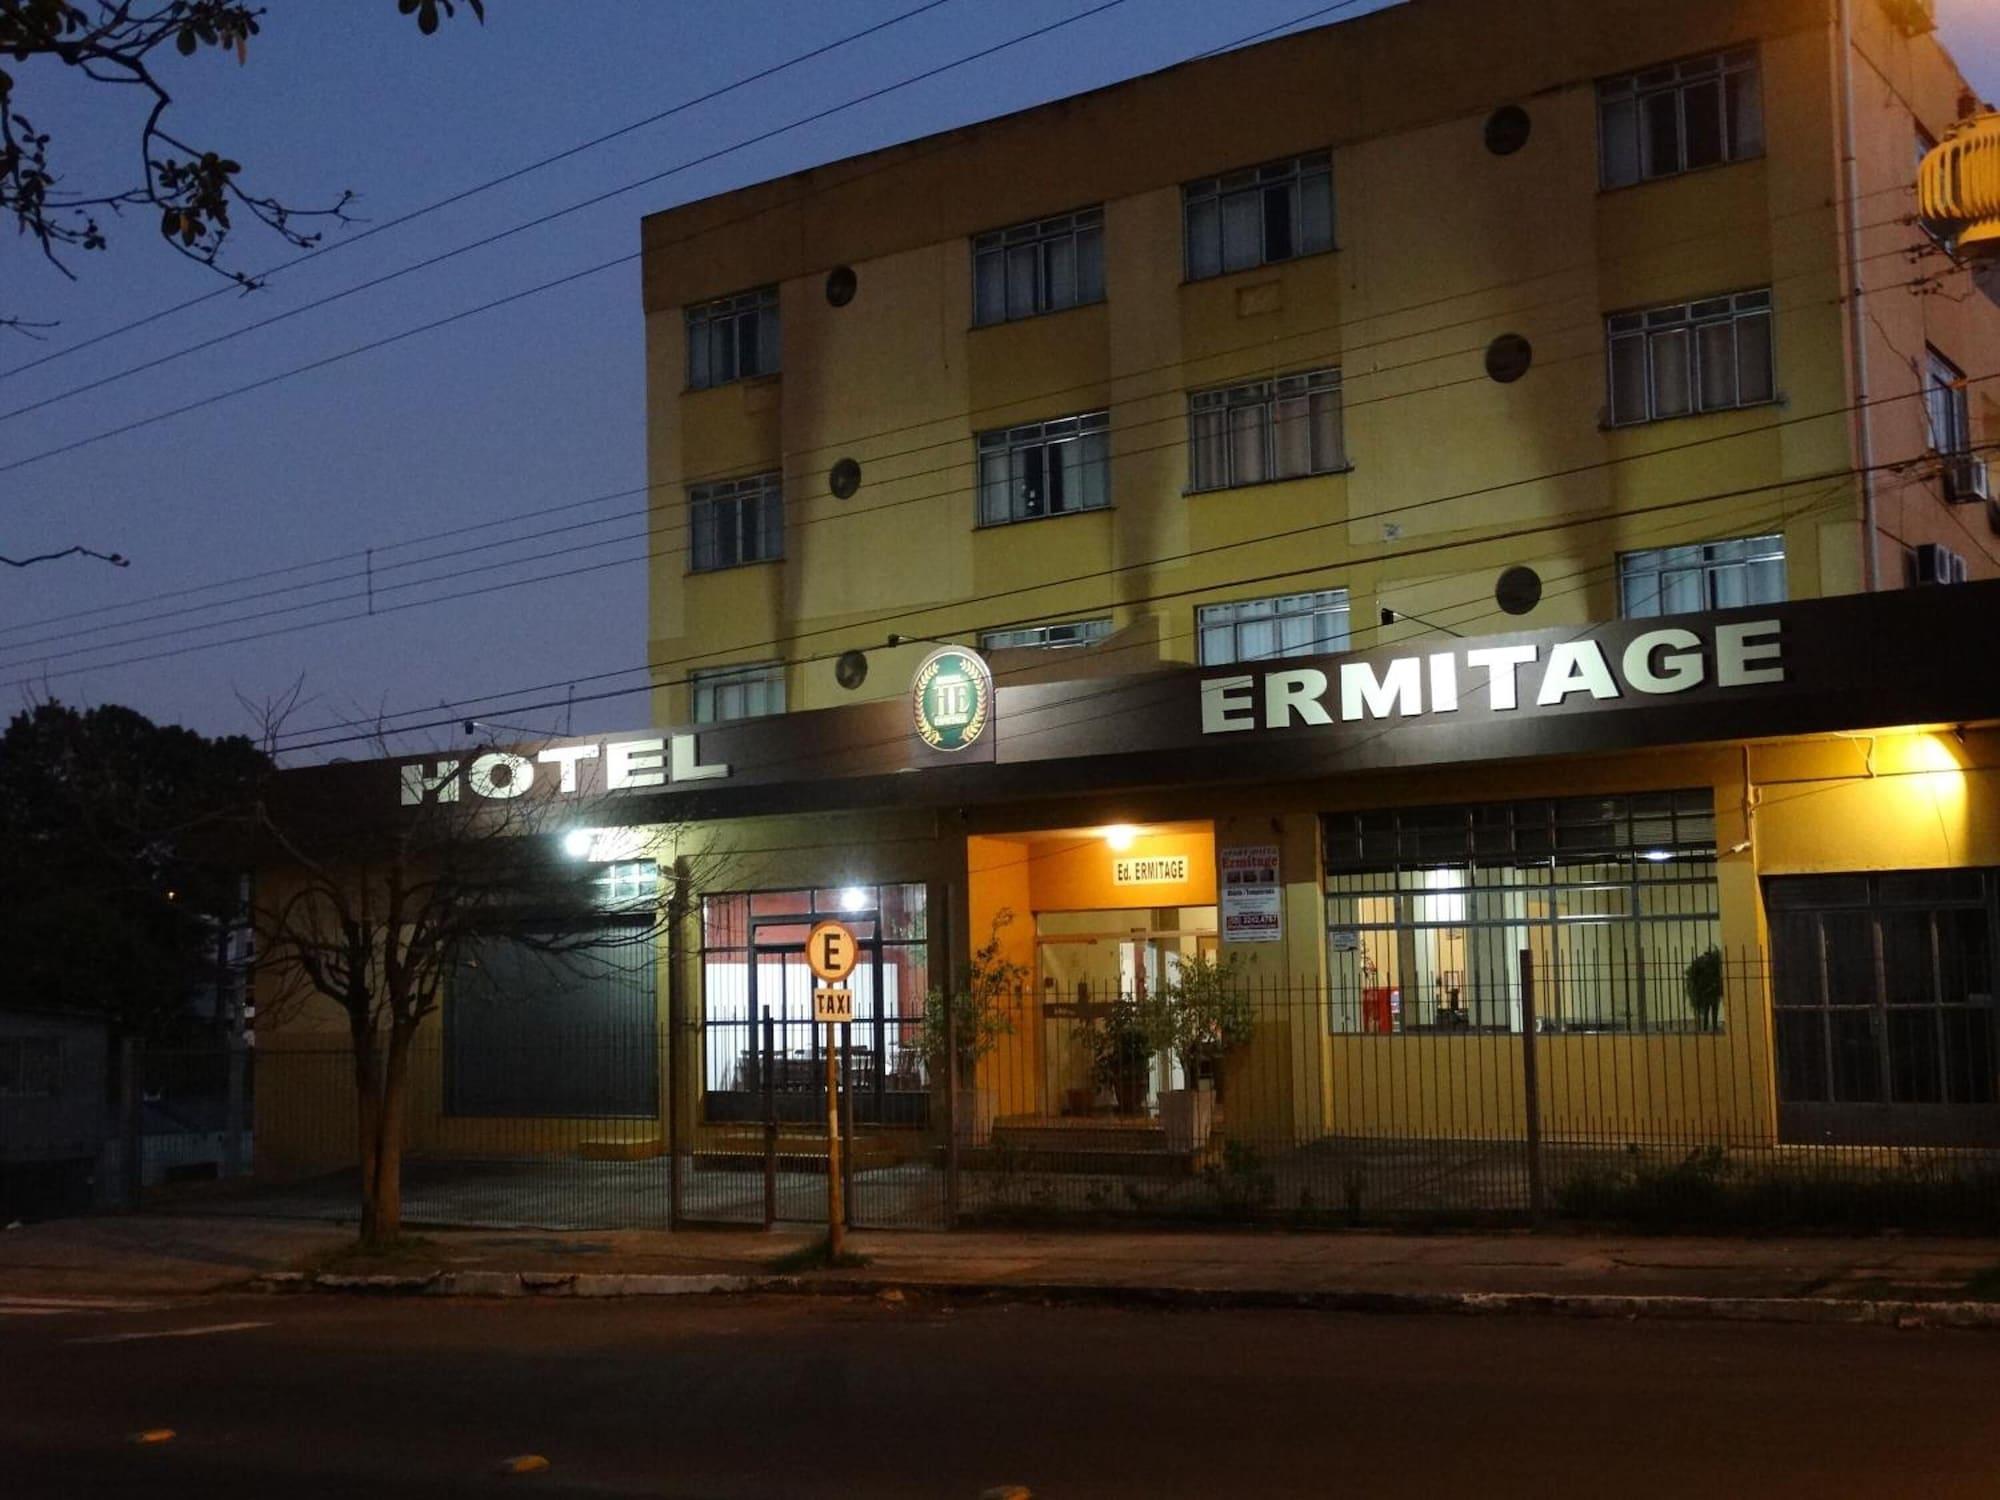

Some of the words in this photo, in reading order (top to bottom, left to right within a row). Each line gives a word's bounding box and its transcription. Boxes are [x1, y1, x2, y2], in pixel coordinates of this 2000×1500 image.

[1200, 619, 1784, 734] ERMITAGE
[401, 733, 731, 806] HOTEL
[1117, 863, 1131, 881] Ed.
[1135, 860, 1184, 881] ERMITAGE
[824, 934, 841, 970] E
[816, 994, 851, 1014] TAXI
